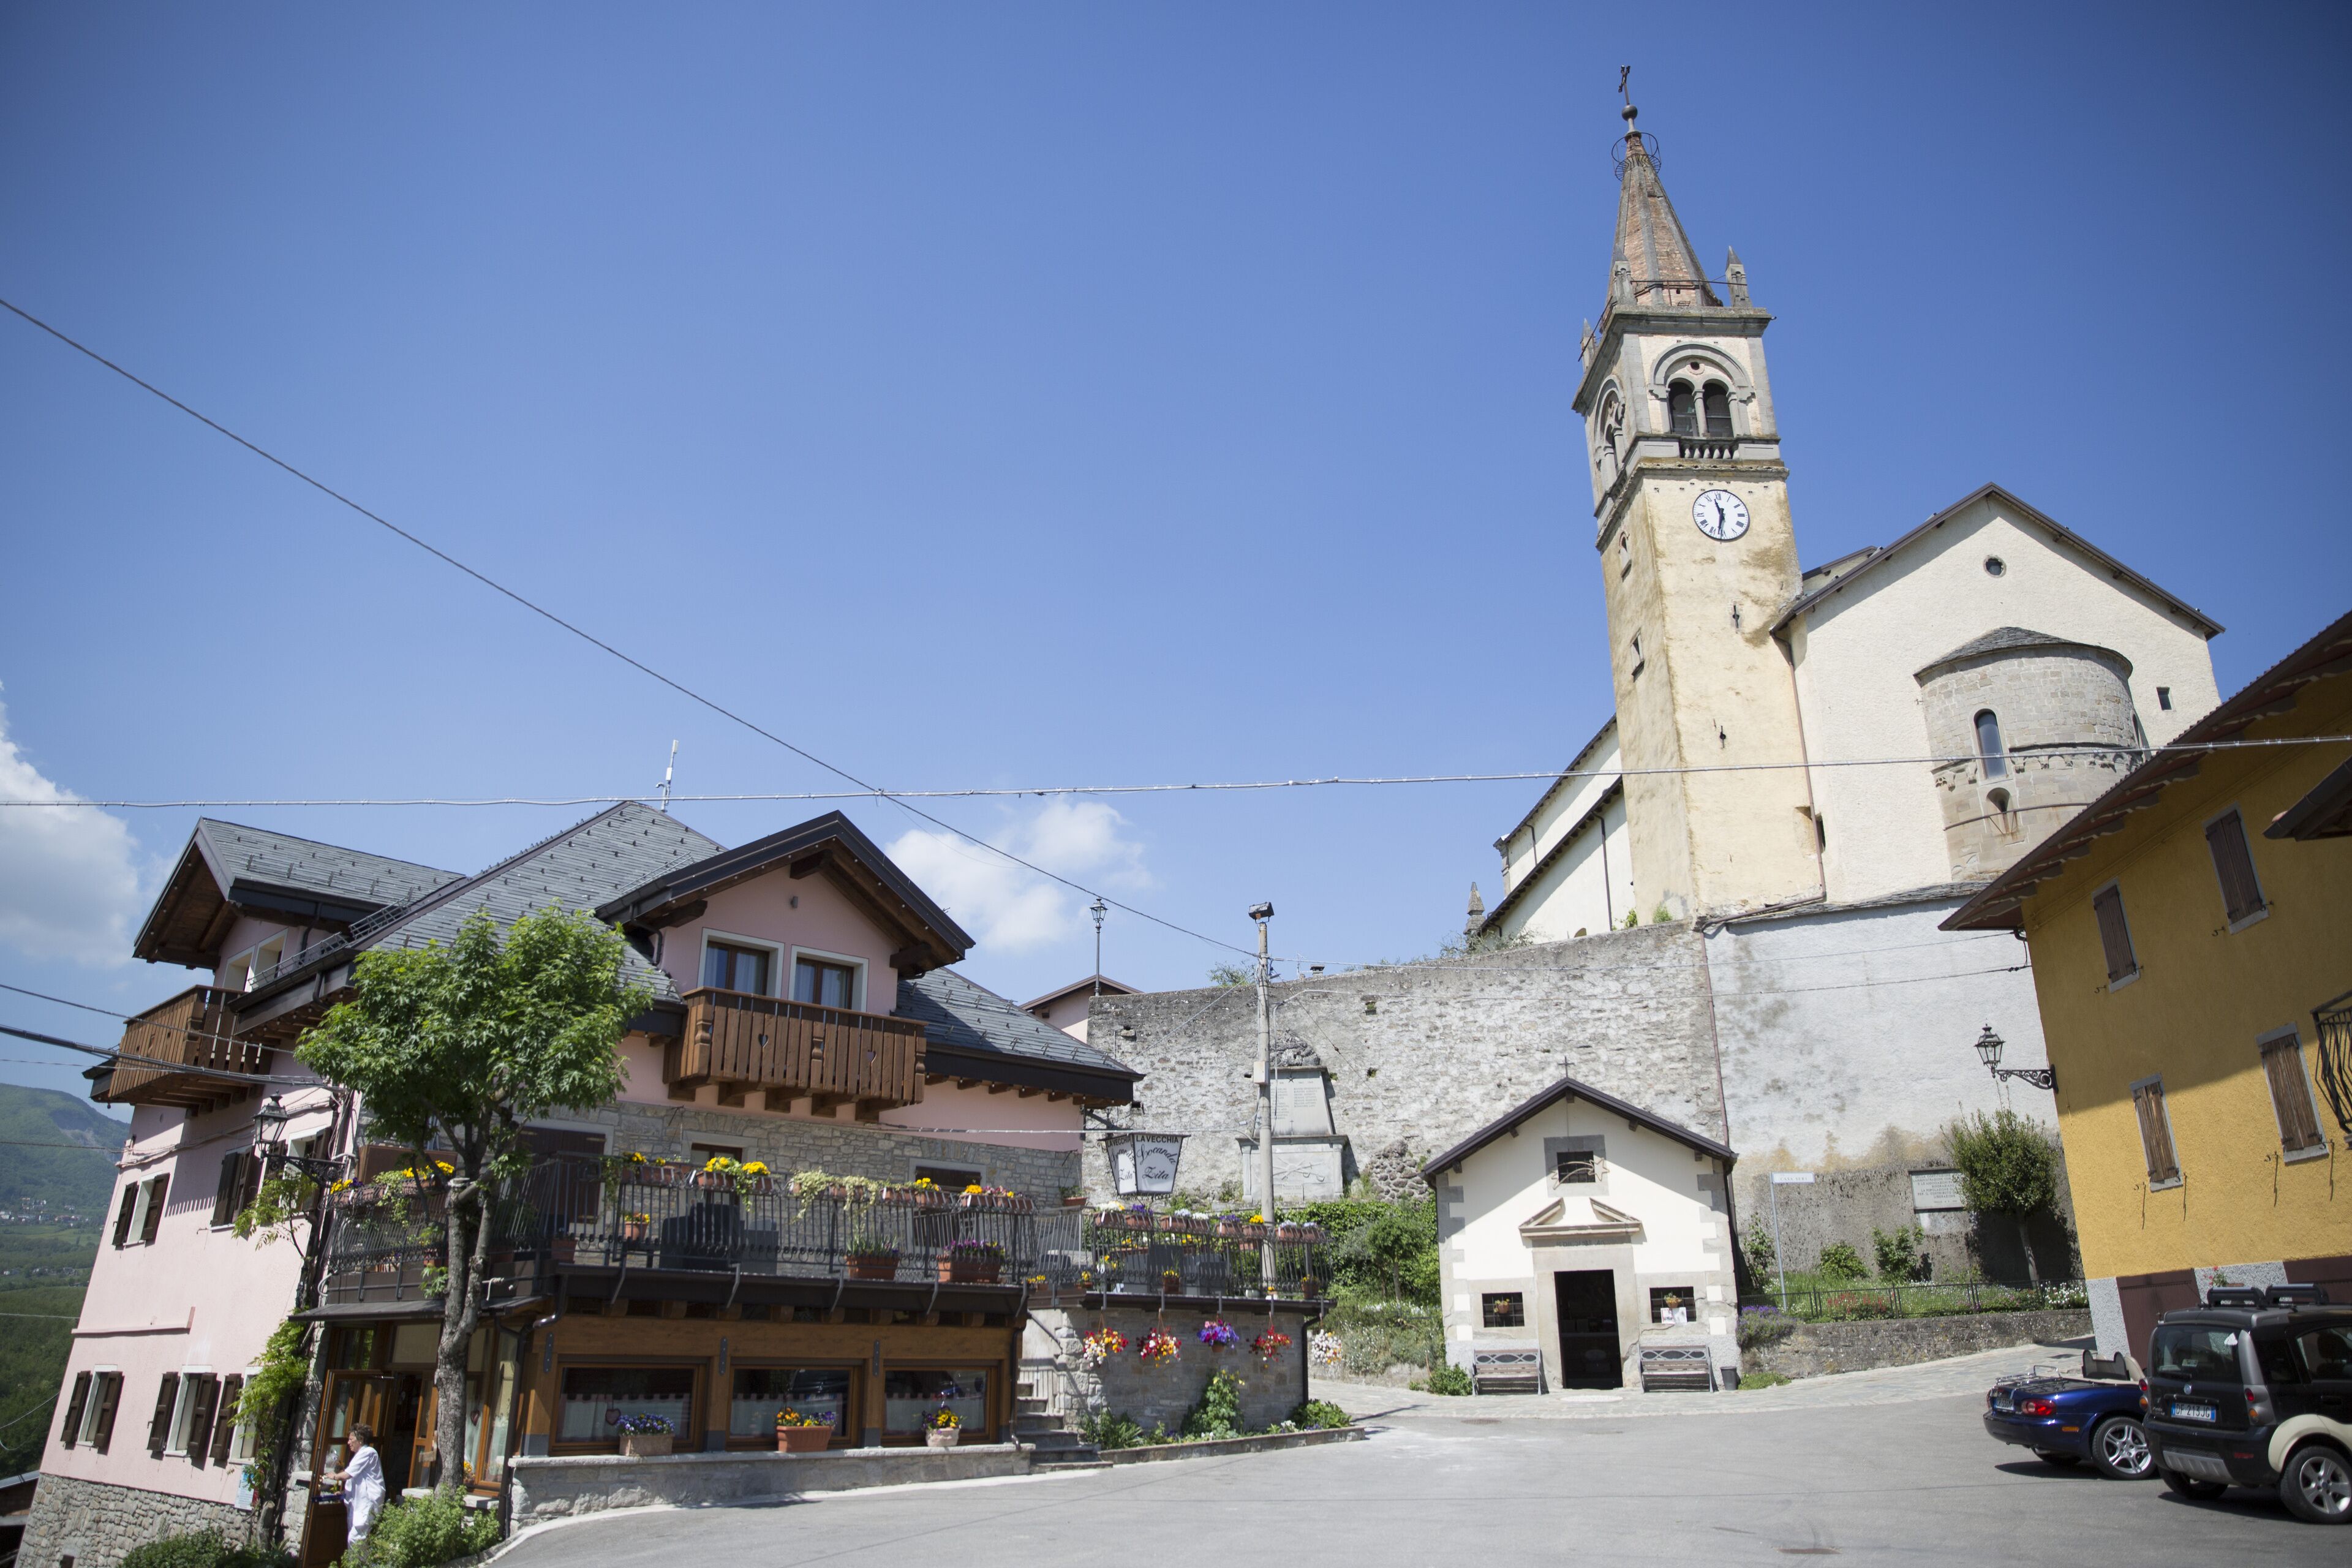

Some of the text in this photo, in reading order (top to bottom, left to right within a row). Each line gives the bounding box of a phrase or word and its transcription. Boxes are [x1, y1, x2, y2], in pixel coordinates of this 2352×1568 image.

[1136, 1144, 1177, 1165] Locanda
[1118, 1168, 1133, 1180] Zita
[1142, 1166, 1169, 1179] Zita
